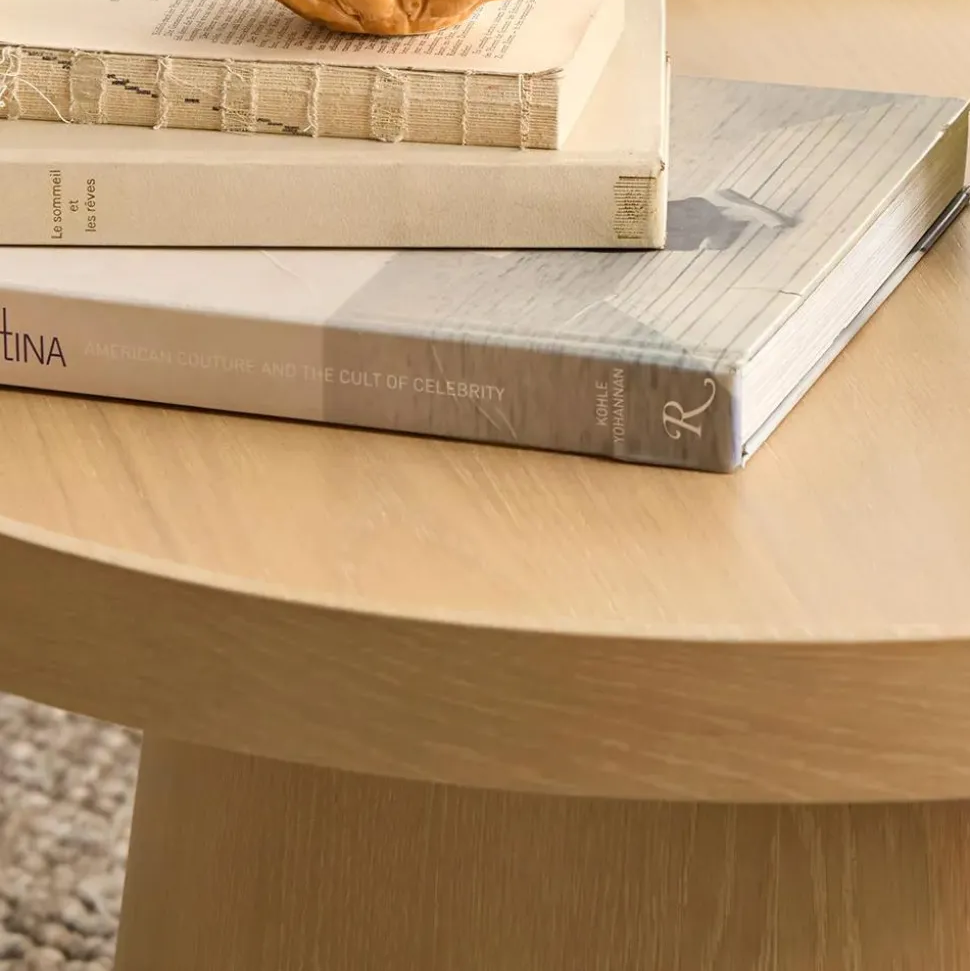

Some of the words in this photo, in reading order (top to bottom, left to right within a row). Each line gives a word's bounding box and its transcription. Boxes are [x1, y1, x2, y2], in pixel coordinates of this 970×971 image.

[49, 169, 62, 223] sommeil
[68, 199, 79, 212] et
[51, 225, 63, 239] Le
[85, 215, 97, 232] les
[84, 340, 172, 364] AMERICAN
[177, 350, 255, 373] COUTURE
[262, 361, 297, 378] AND
[302, 364, 335, 382] THE
[339, 369, 383, 388] CULT
[386, 374, 409, 391] OF
[413, 377, 506, 401] CELEBRITY
[595, 380, 608, 426] KOHLE
[612, 368, 625, 443] YOHANNAN
[662, 377, 716, 440] R
